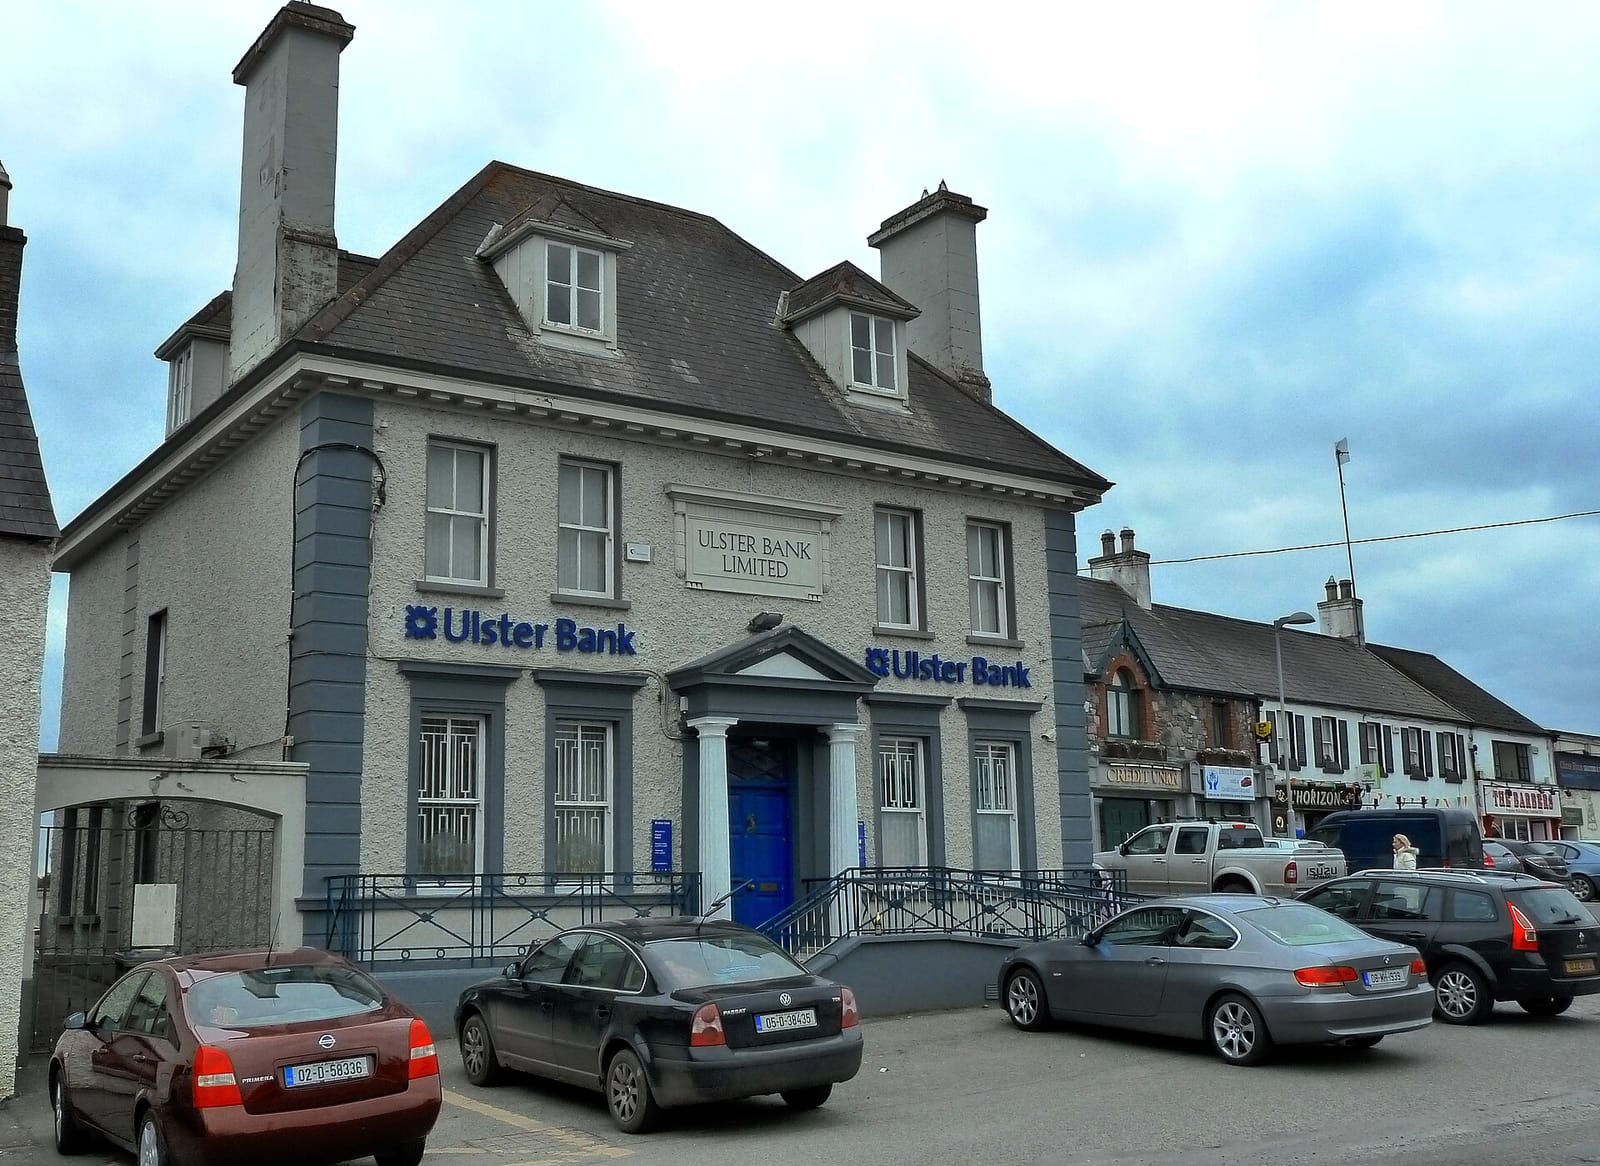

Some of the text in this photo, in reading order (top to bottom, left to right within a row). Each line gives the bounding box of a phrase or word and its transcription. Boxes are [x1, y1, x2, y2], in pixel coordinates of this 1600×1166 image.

[698, 529, 811, 560] ULSTER BANK
[722, 554, 789, 578] LIMITED
[443, 607, 637, 656] Ulster Bank
[893, 649, 1033, 689] Ulster Bank
[1107, 768, 1179, 786] CREDIT UNION
[1306, 866, 1338, 876] ISUZU
[765, 1012, 811, 1029] 05-D-38435
[298, 1061, 363, 1082] 02-D-58336
